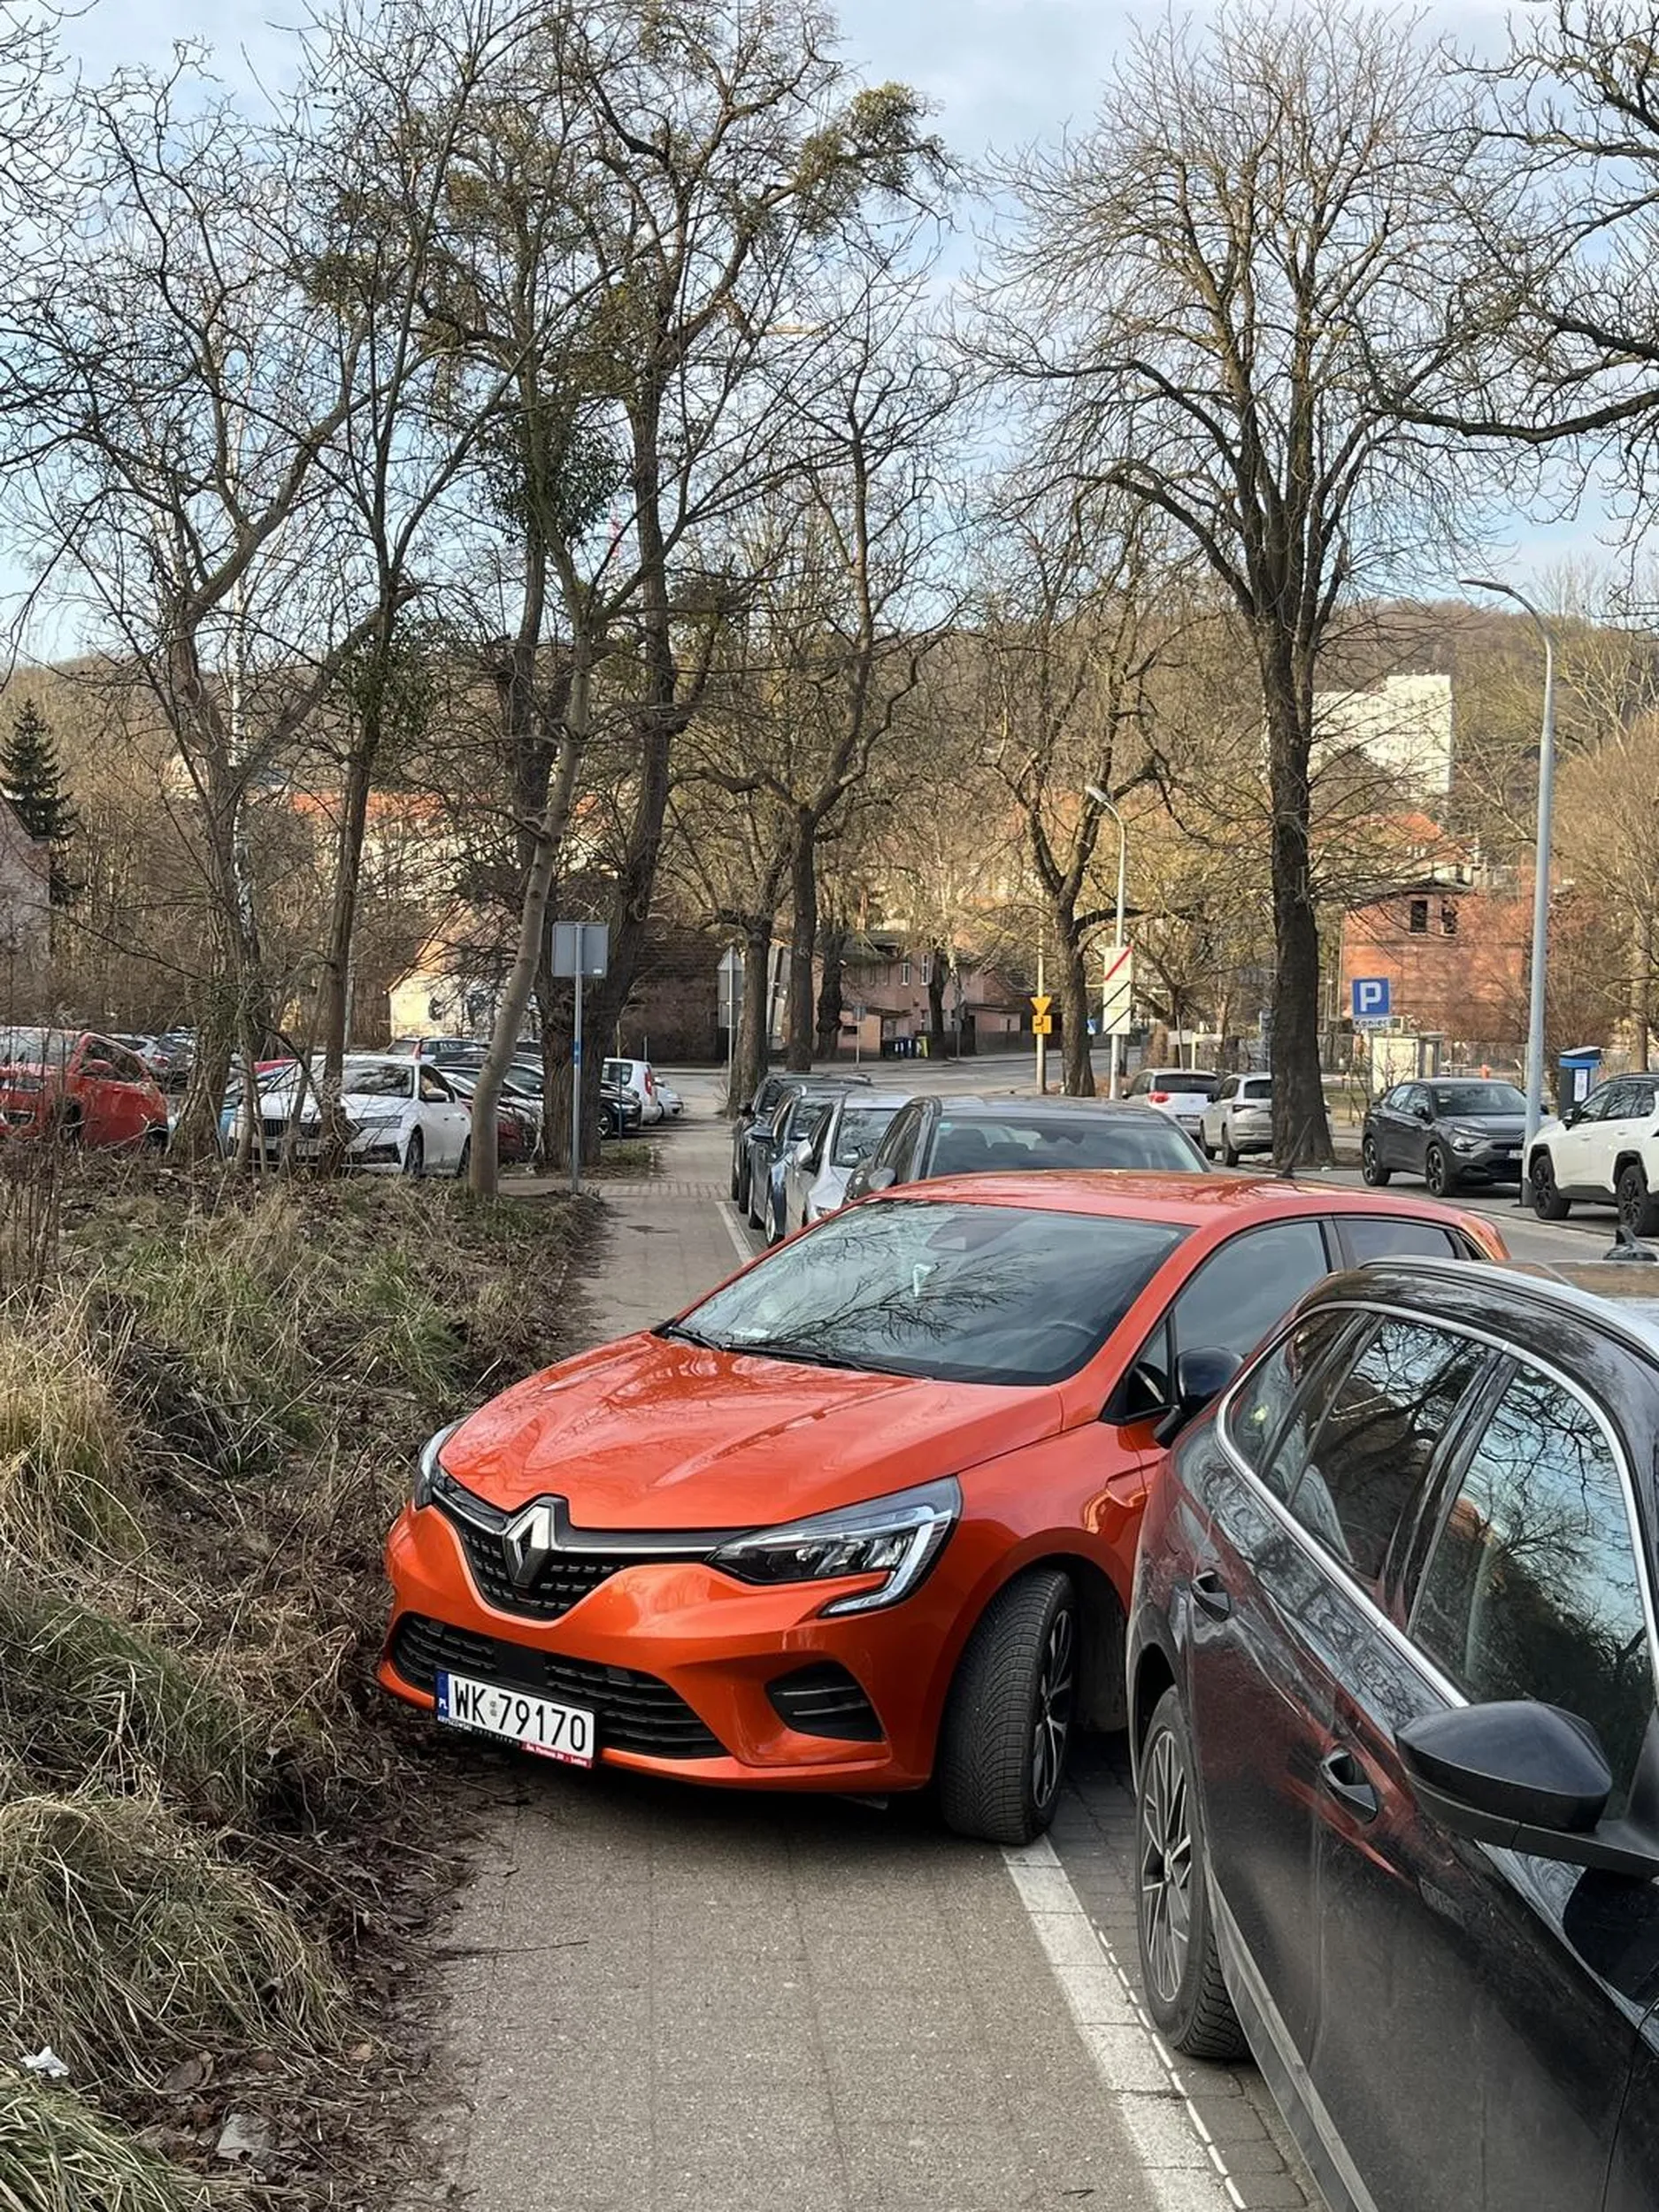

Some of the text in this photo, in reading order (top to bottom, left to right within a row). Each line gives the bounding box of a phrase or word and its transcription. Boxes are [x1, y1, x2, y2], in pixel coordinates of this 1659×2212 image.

[1359, 982, 1382, 1012] P
[439, 1697, 448, 1710] PL
[454, 1680, 586, 1752] WK 79170
